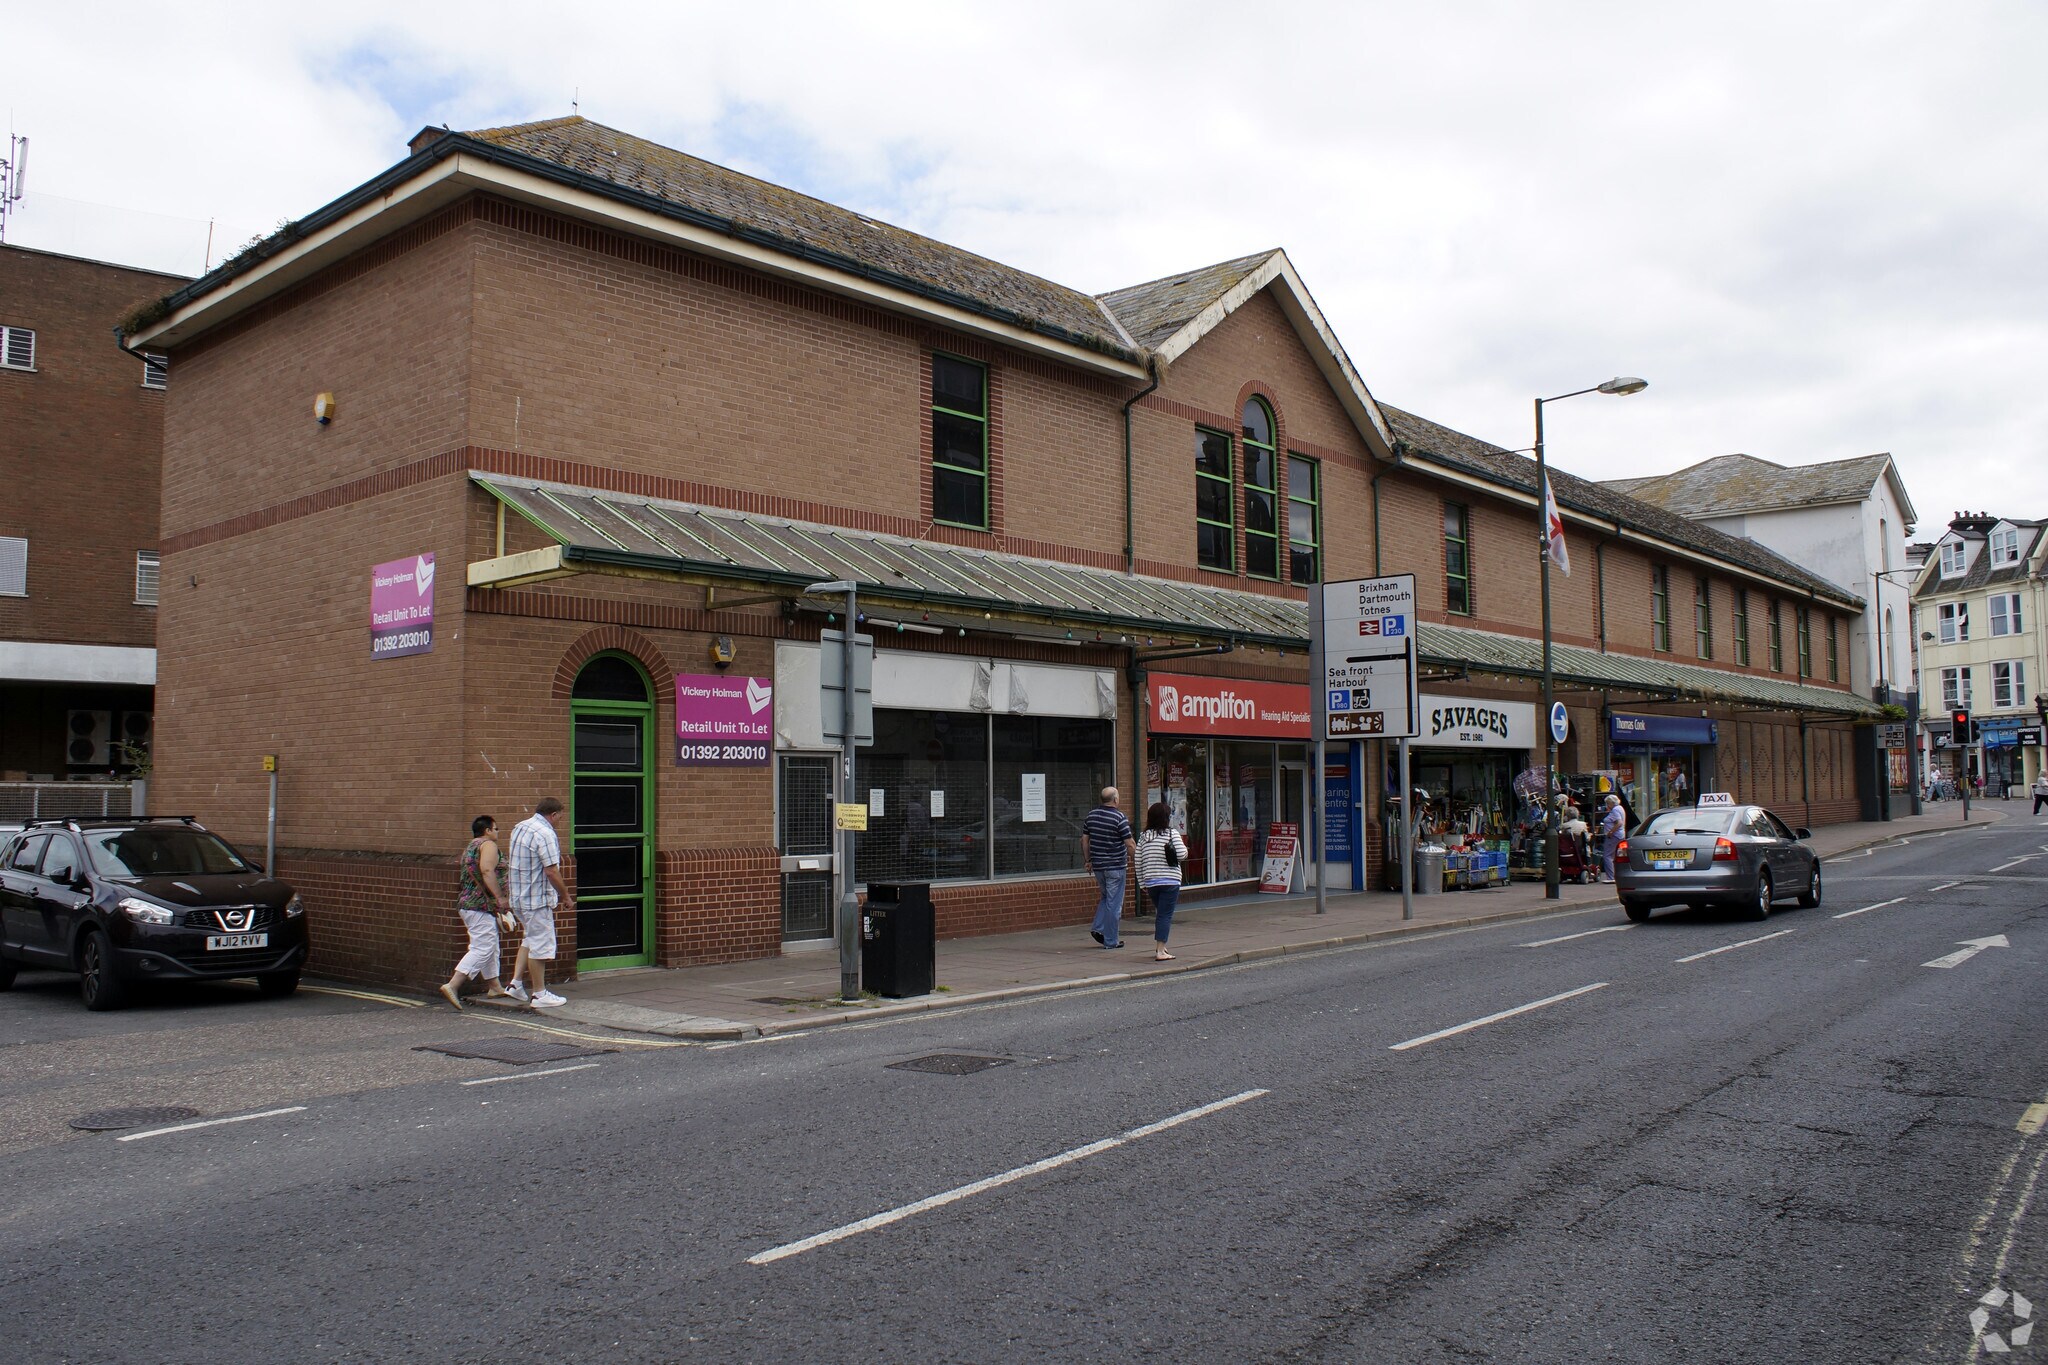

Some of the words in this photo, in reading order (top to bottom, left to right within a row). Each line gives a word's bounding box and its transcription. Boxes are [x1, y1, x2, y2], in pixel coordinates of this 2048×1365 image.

[375, 576, 392, 588] Vickery
[394, 573, 413, 584] Holman
[1359, 582, 1398, 593] Brixham
[1360, 592, 1410, 604] Dartmouth
[374, 612, 393, 624] Retail
[394, 608, 408, 621] Unit
[410, 606, 417, 618] To
[419, 605, 430, 617] Let
[1359, 606, 1391, 616] Totnes
[1385, 617, 1396, 635] P
[374, 635, 397, 652] 01392
[399, 630, 430, 648] 203010
[1329, 668, 1346, 677] Sea
[1350, 666, 1373, 676] front
[1329, 677, 1367, 687] Harbour
[681, 686, 710, 698] Vickery
[712, 688, 742, 698] Holman
[1331, 692, 1342, 709] P
[1182, 691, 1255, 724] amplifon
[1261, 710, 1281, 723] Hearing
[1282, 711, 1290, 721] Aid
[1290, 712, 1310, 724] Specialis
[1432, 707, 1508, 739] SAVAGES
[681, 720, 712, 732] Retail
[714, 722, 736, 733] Unit
[738, 722, 750, 733] To
[752, 723, 768, 734] Let
[1615, 718, 1634, 729] Thomas
[1634, 719, 1646, 730] Cook
[681, 745, 719, 759] 01392
[722, 746, 766, 759] 203010
[1325, 788, 1350, 799] aring
[1702, 794, 1727, 802] TAXI
[1325, 799, 1348, 807] entre
[215, 937, 238, 947] WJ12
[241, 935, 261, 945] RVV
